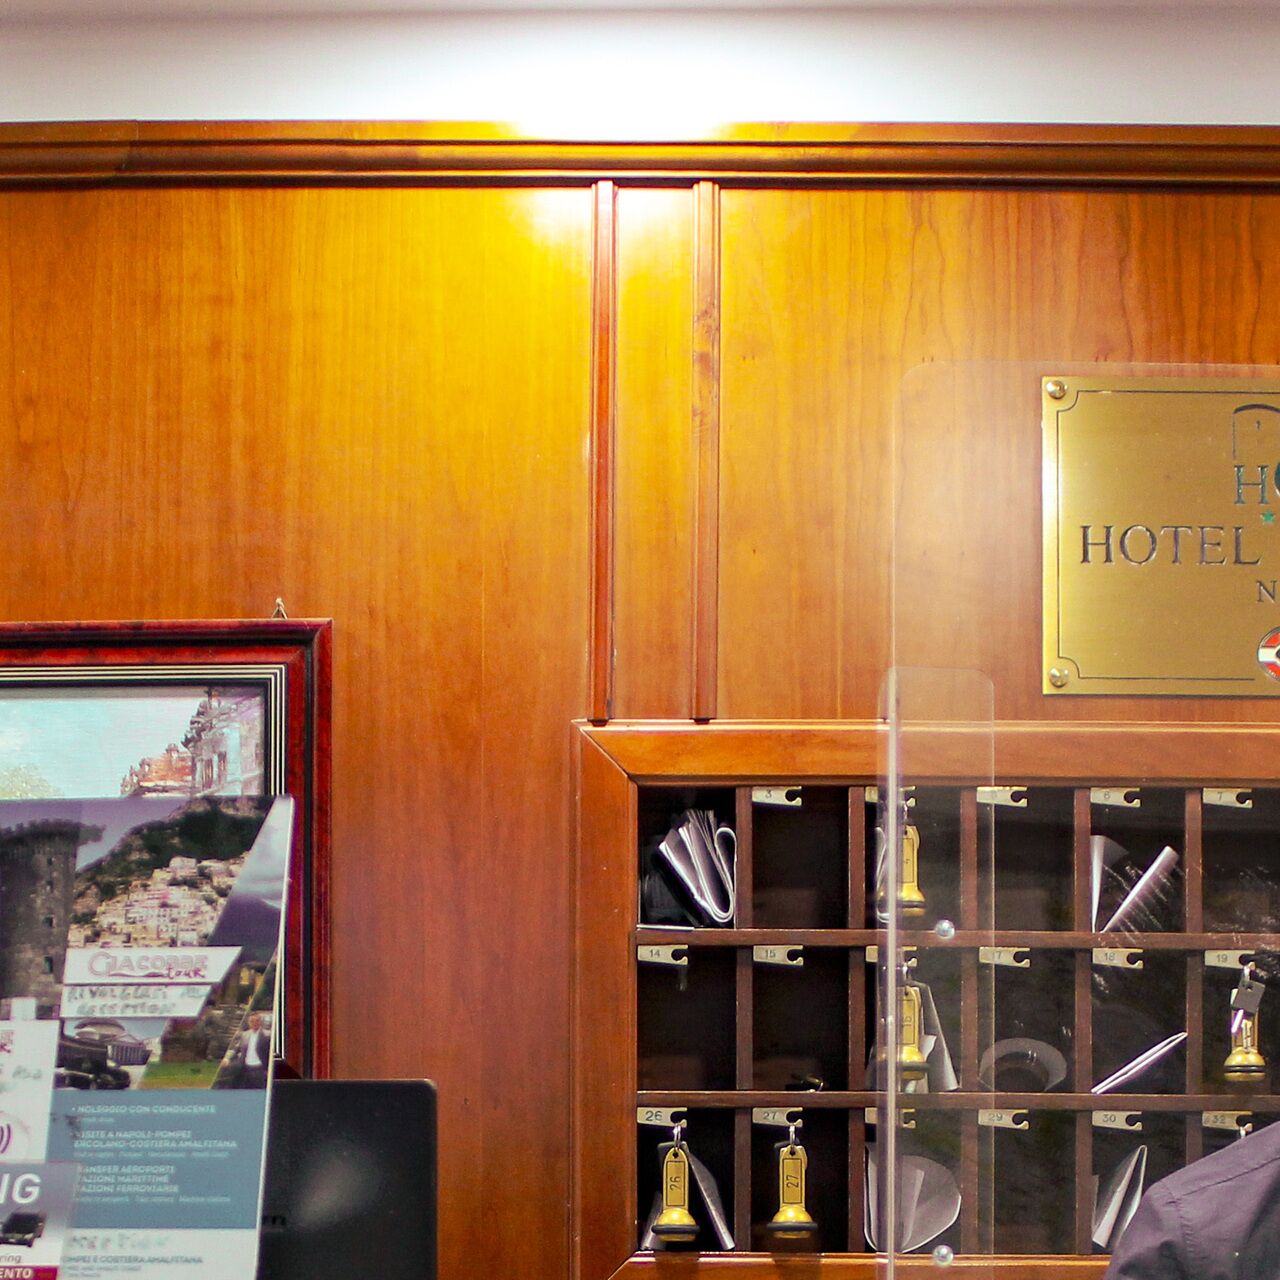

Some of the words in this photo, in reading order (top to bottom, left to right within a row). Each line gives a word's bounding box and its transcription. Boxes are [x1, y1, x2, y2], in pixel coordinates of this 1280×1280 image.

[1080, 525, 1260, 566] HOTEL
[649, 949, 660, 958] 14
[764, 949, 776, 959] 15
[1216, 953, 1228, 963] 19
[645, 1110, 663, 1122] 26
[762, 1111, 777, 1121] 27
[1102, 1113, 1117, 1123] 30
[1212, 1114, 1226, 1124] 32
[786, 1174, 800, 1189] 27
